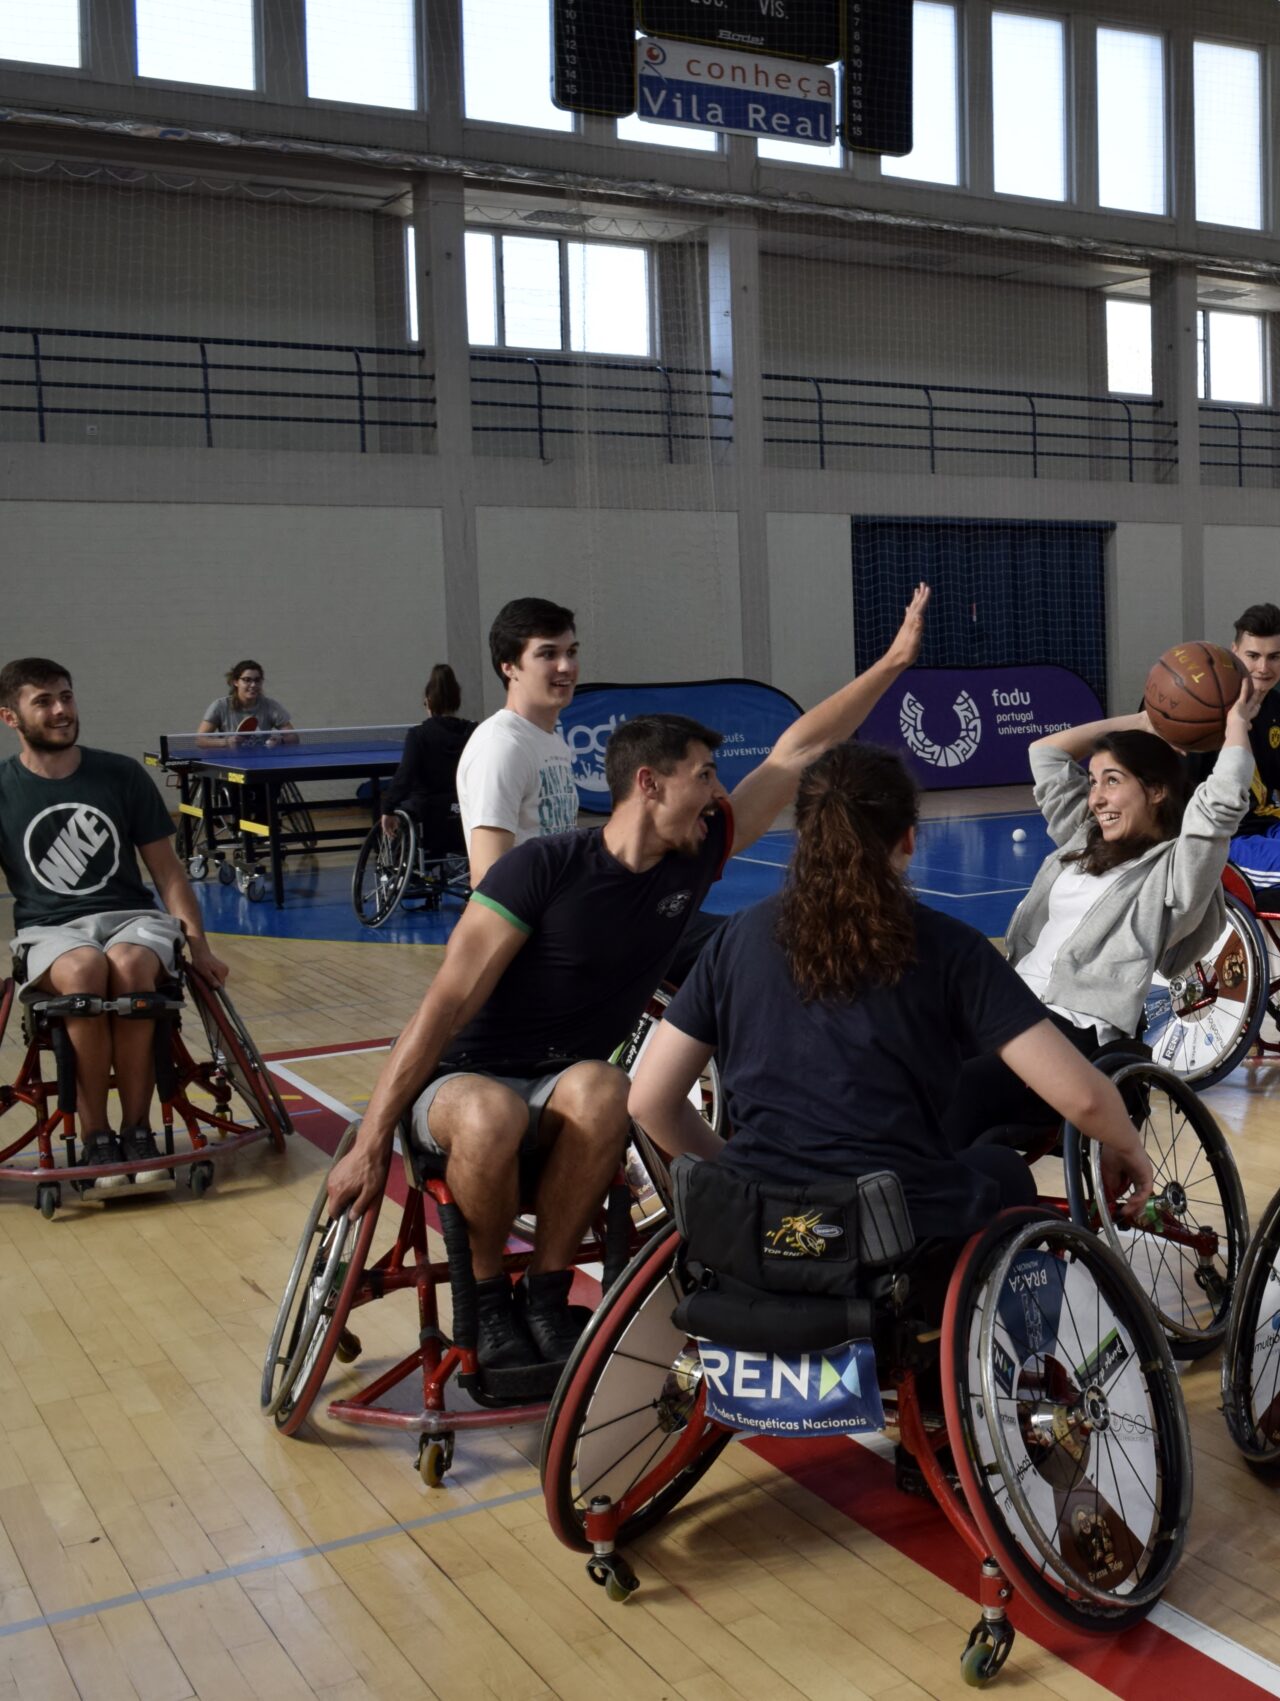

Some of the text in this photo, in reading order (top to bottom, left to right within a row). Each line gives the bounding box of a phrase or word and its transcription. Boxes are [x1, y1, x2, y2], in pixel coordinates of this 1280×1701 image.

[686, 58, 832, 99] conheça
[643, 87, 828, 141] Vila Real
[992, 688, 1030, 707] fadu
[996, 711, 1034, 723] portugal
[722, 733, 744, 743] GUÊS
[998, 722, 1072, 735] university sports
[38, 807, 110, 894] NIKE
[700, 1349, 810, 1400] REN
[737, 1412, 800, 1430] Energéticas
[803, 1416, 867, 1429] Nacionais
